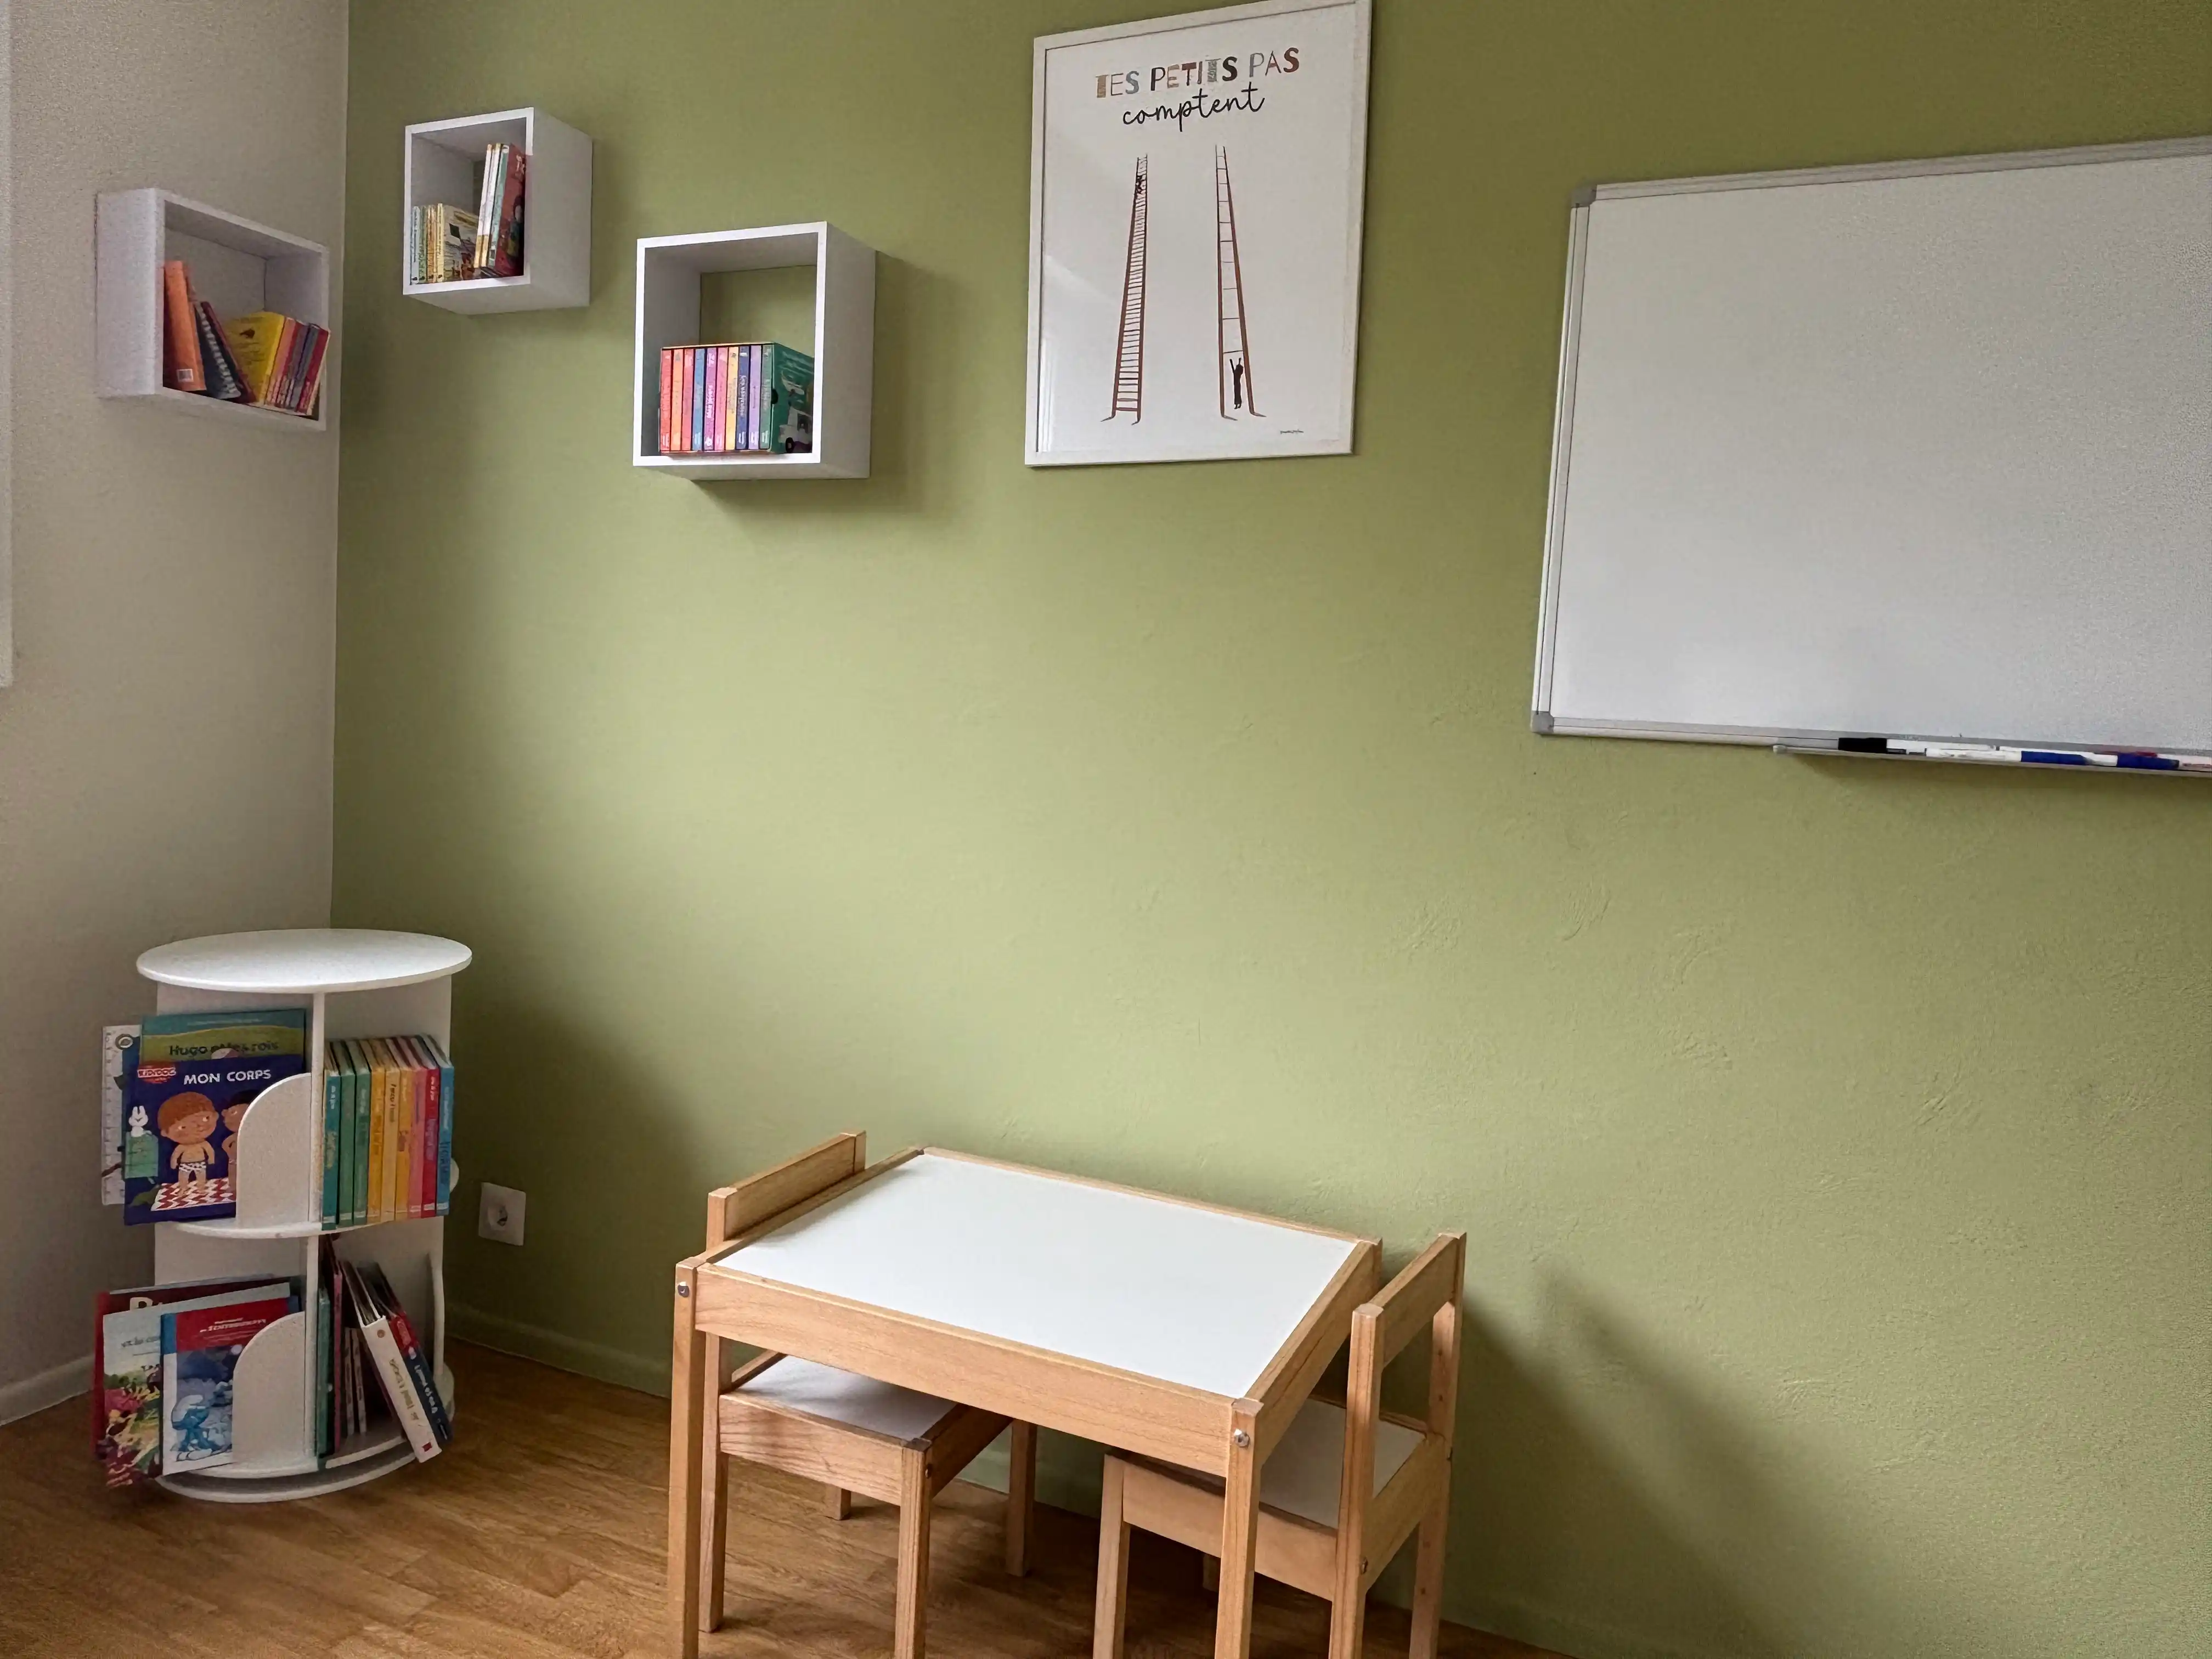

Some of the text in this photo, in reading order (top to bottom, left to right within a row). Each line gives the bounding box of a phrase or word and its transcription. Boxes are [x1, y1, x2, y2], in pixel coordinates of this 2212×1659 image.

[1150, 57, 1238, 91] PETITS
[1249, 47, 1299, 77] PAS
[1123, 82, 1265, 132] comptent
[169, 1045, 208, 1058] Hugo
[184, 1069, 272, 1085] MON CORPS
